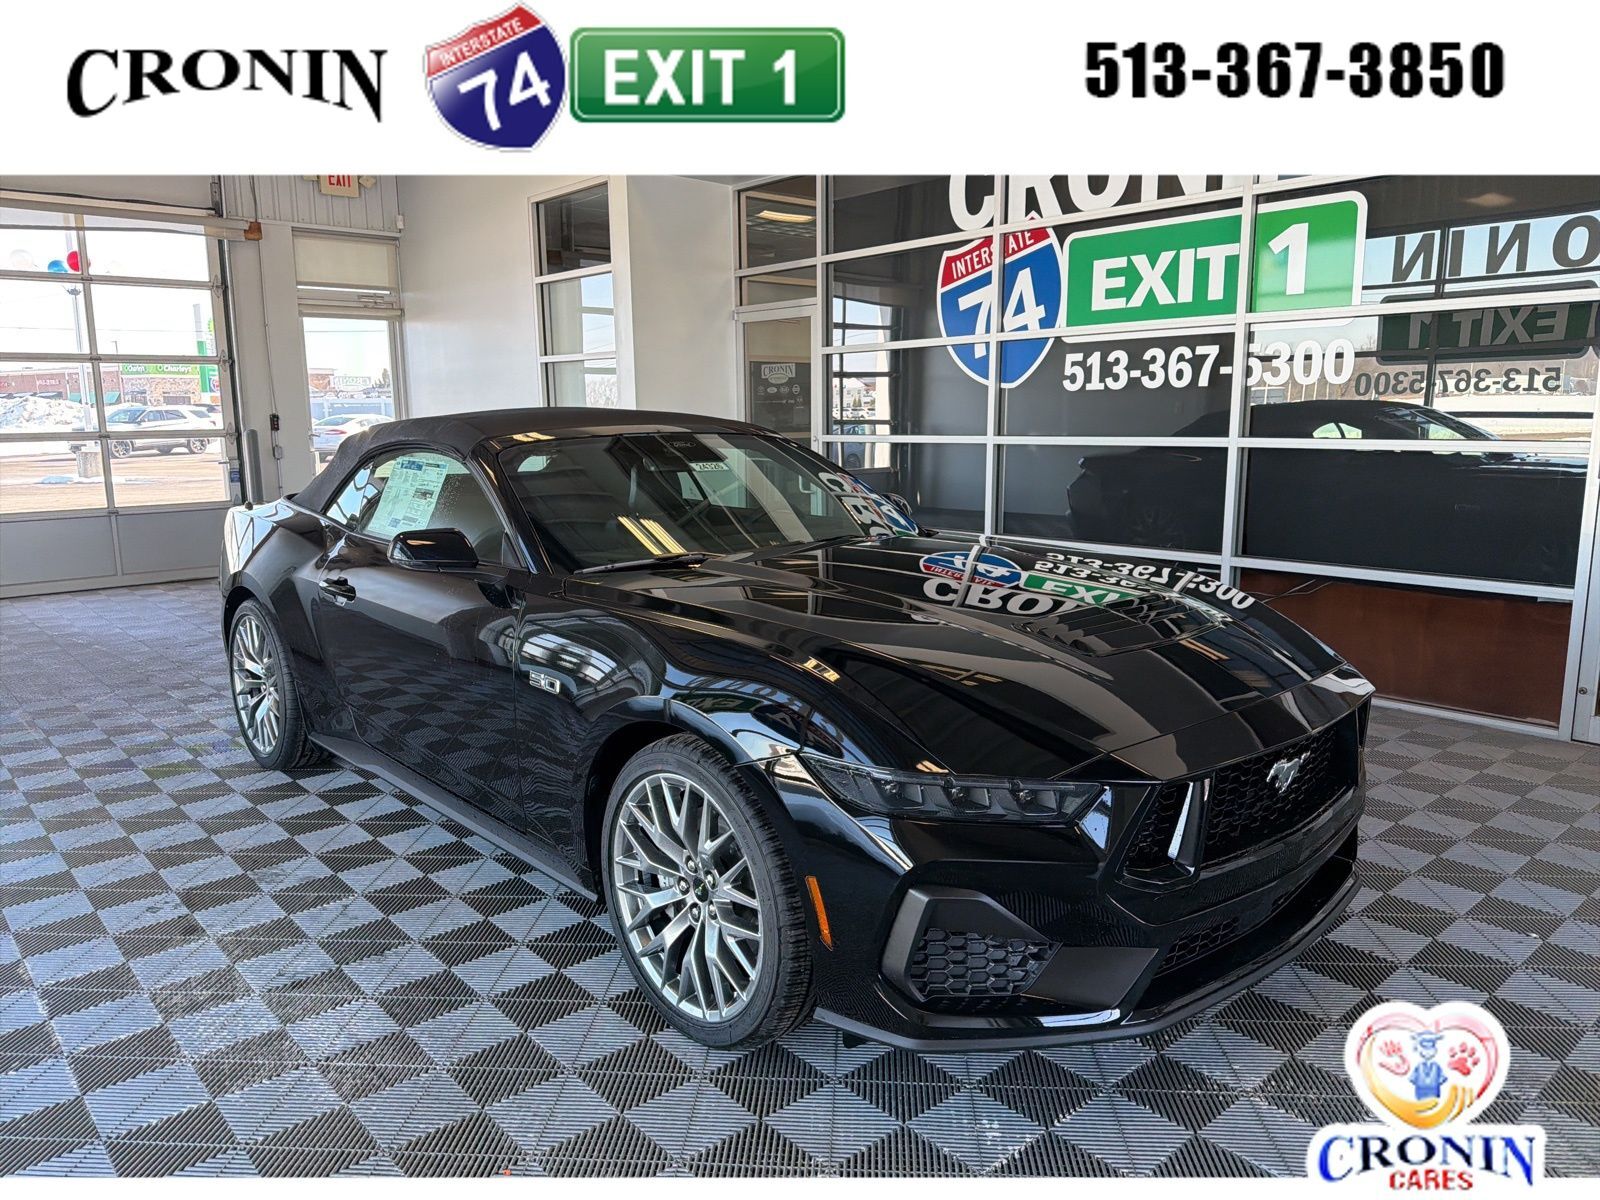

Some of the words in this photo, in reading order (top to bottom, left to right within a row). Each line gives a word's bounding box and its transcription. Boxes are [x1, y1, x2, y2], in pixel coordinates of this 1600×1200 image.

[952, 231, 1034, 279] INTERSATE
[1091, 243, 1240, 311] EXIT
[1267, 223, 1309, 295] 1
[957, 267, 1046, 359] 74
[763, 365, 794, 377] CRONIN
